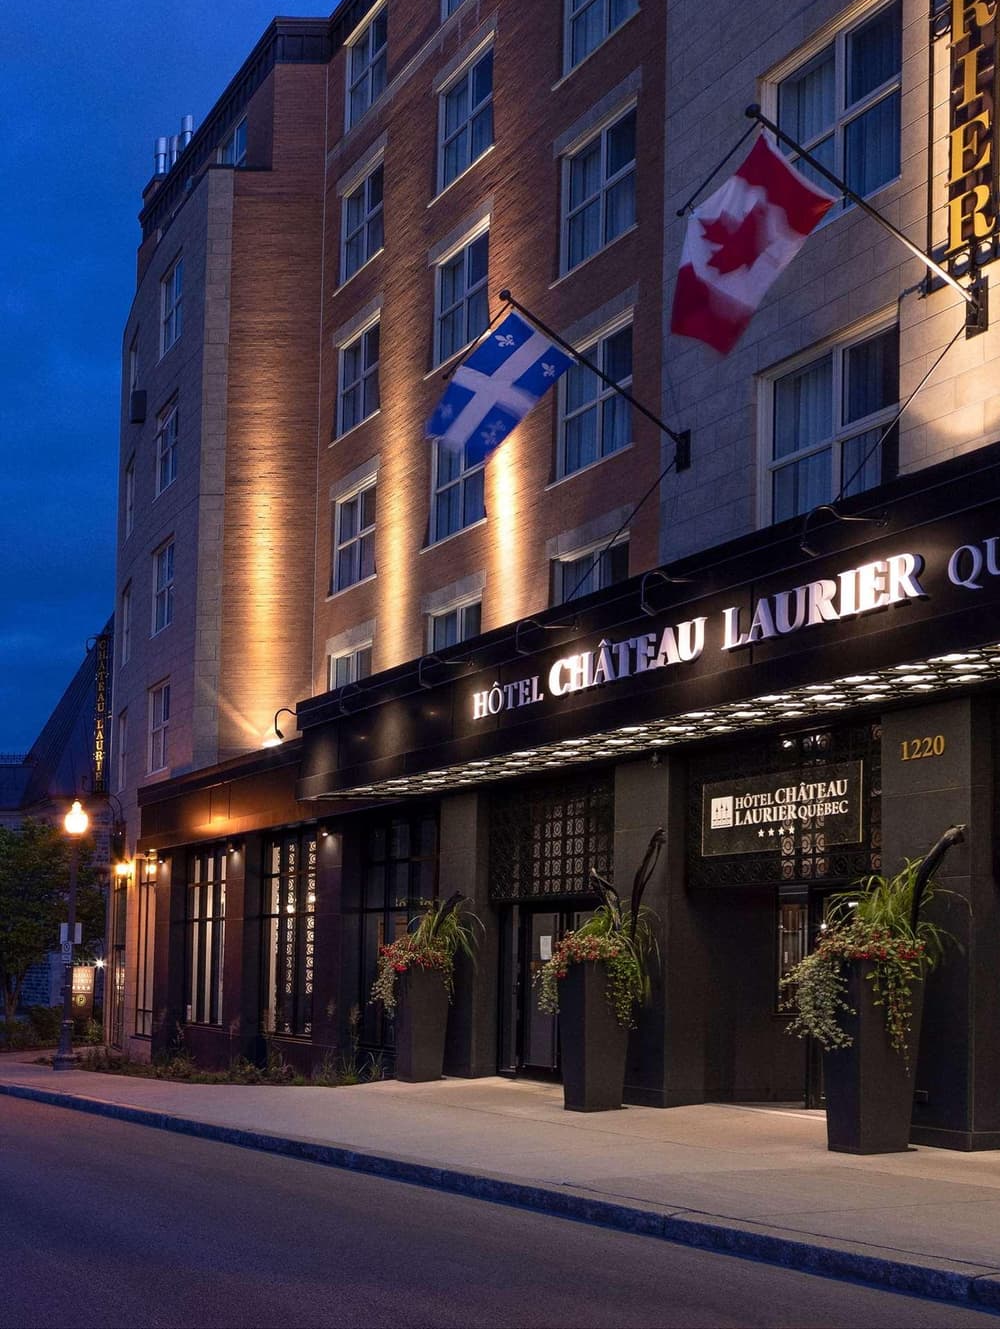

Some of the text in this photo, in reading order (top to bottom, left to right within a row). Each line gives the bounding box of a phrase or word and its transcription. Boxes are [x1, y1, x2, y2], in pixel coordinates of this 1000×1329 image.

[473, 675, 544, 719] HÔTEL
[549, 617, 708, 696] CHÂTEAU
[721, 552, 928, 651] LAURIER
[901, 735, 944, 760] 1220
[735, 779, 848, 809] HÔTEL CHÂTEAU
[735, 798, 849, 826] LAURIER QUÉBEC
